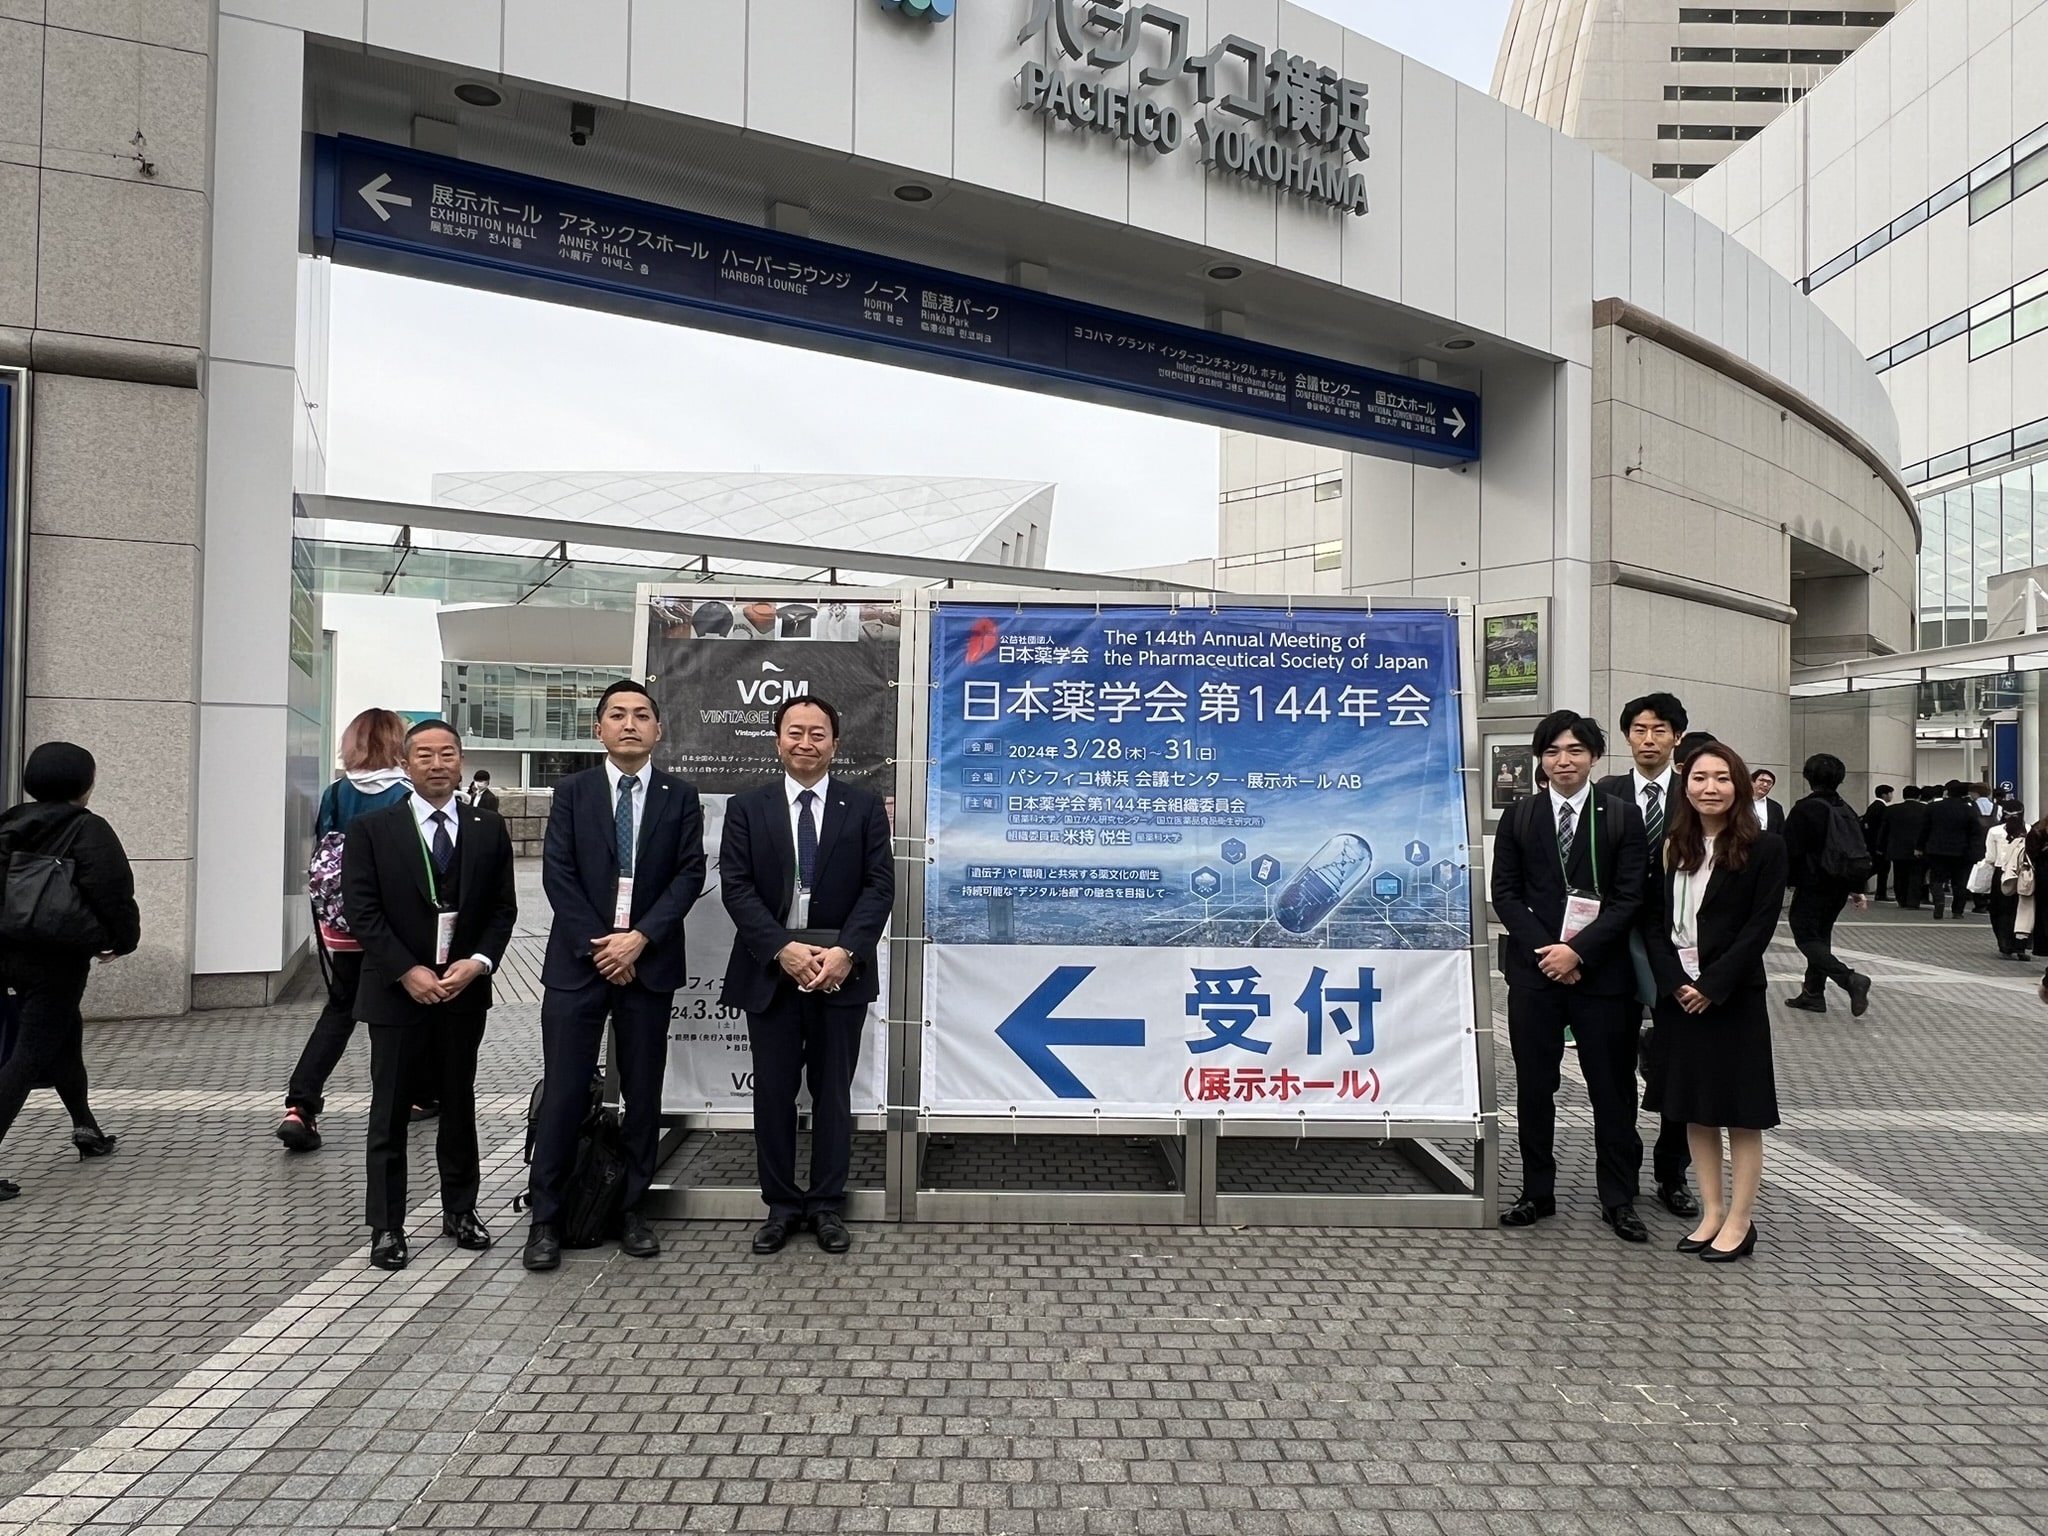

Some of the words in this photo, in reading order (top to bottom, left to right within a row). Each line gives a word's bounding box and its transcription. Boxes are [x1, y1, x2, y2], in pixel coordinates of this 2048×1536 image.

[1020, 60, 1183, 154] PACIFICO
[1194, 118, 1369, 216] YOKOHAMA
[432, 184, 542, 223] 展示ホール
[430, 206, 502, 232] EXHIBITION
[507, 222, 537, 239] HALL
[558, 234, 599, 252] ANNEX
[603, 242, 632, 259] HALL
[559, 212, 709, 260] アネックスホール
[722, 249, 851, 289] ハーバーラウンジ
[721, 268, 764, 286] HARBOR
[768, 277, 808, 295] LOUNGE
[864, 281, 909, 303] ノース
[863, 297, 893, 312] NORTH
[921, 290, 999, 320] 臨港パーク
[949, 315, 970, 328] Park
[1074, 326, 1113, 344] ヨコハマ
[1117, 336, 1155, 353] グランド
[1160, 346, 1258, 376] インターコンチネンタル
[1261, 368, 1286, 382] ホテル
[1295, 373, 1360, 396] 会議センター
[1295, 389, 1335, 406] CONFERENCE
[1336, 398, 1361, 411] CENTER
[1375, 390, 1436, 415] 国立大ホール
[1367, 404, 1392, 418] NATIONAL
[1393, 409, 1424, 423] CONVENTION
[1424, 415, 1437, 426] HALL
[1000, 635, 1055, 645] 公益社団法人
[1104, 630, 1138, 645] The
[1145, 630, 1196, 646] 144th
[1202, 631, 1264, 647] Annual
[1270, 632, 1342, 653] Meeting
[1347, 633, 1366, 649] of
[999, 646, 1089, 664] 日本薬学会
[1104, 650, 1132, 666] the
[1138, 650, 1275, 668] Pharmaceutical
[1281, 652, 1345, 674] Society
[1351, 653, 1369, 669] of
[1374, 653, 1428, 674] Japan
[736, 679, 809, 705] VCM
[964, 680, 1188, 725] 日本薬学会
[1198, 681, 1432, 728] 第144年会
[700, 710, 770, 724] VINTAGE
[735, 729, 760, 737] Vintage
[971, 742, 994, 752] 会期
[1008, 745, 1059, 759] 2024年
[971, 772, 993, 783] 会場
[1008, 769, 1129, 787] パシフィコ横浜
[1337, 774, 1362, 789] AB
[1008, 796, 1245, 814] 日本薬学会第144年会組織委員会
[1063, 829, 1094, 845] 米持
[1100, 829, 1131, 845] 悦生
[1185, 965, 1382, 1055] 受付
[1183, 1066, 1381, 1102] (展示ホール)
